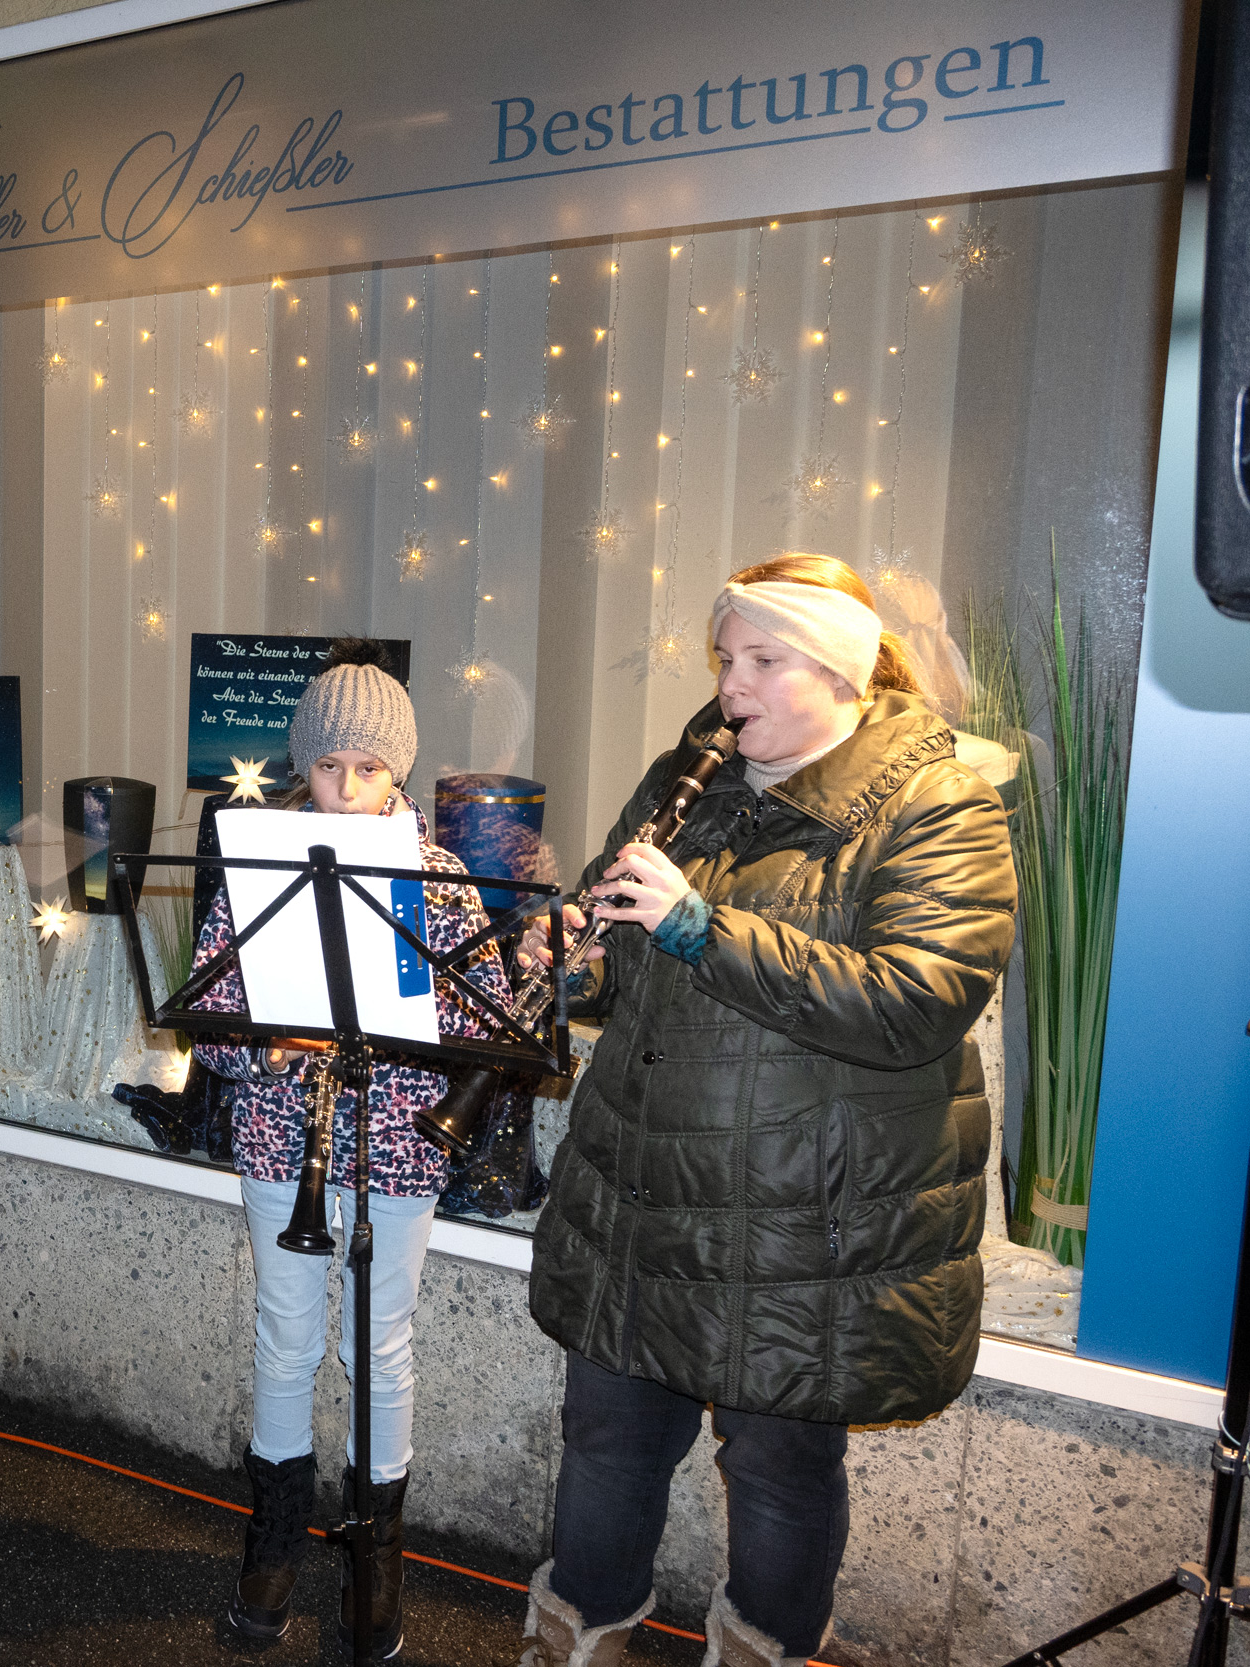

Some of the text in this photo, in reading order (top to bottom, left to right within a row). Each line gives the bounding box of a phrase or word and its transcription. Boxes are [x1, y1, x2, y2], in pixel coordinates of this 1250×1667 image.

[41, 168, 82, 236] &
[100, 72, 355, 260] Schießler
[489, 32, 1051, 165] Bestattungen
[249, 641, 289, 658] Sterne
[292, 645, 310, 659] des
[196, 665, 234, 679] können
[237, 669, 255, 680] wir
[258, 669, 305, 683] einander
[212, 686, 245, 703] Aber
[248, 691, 264, 704] die
[201, 709, 288, 728] der Freude und
